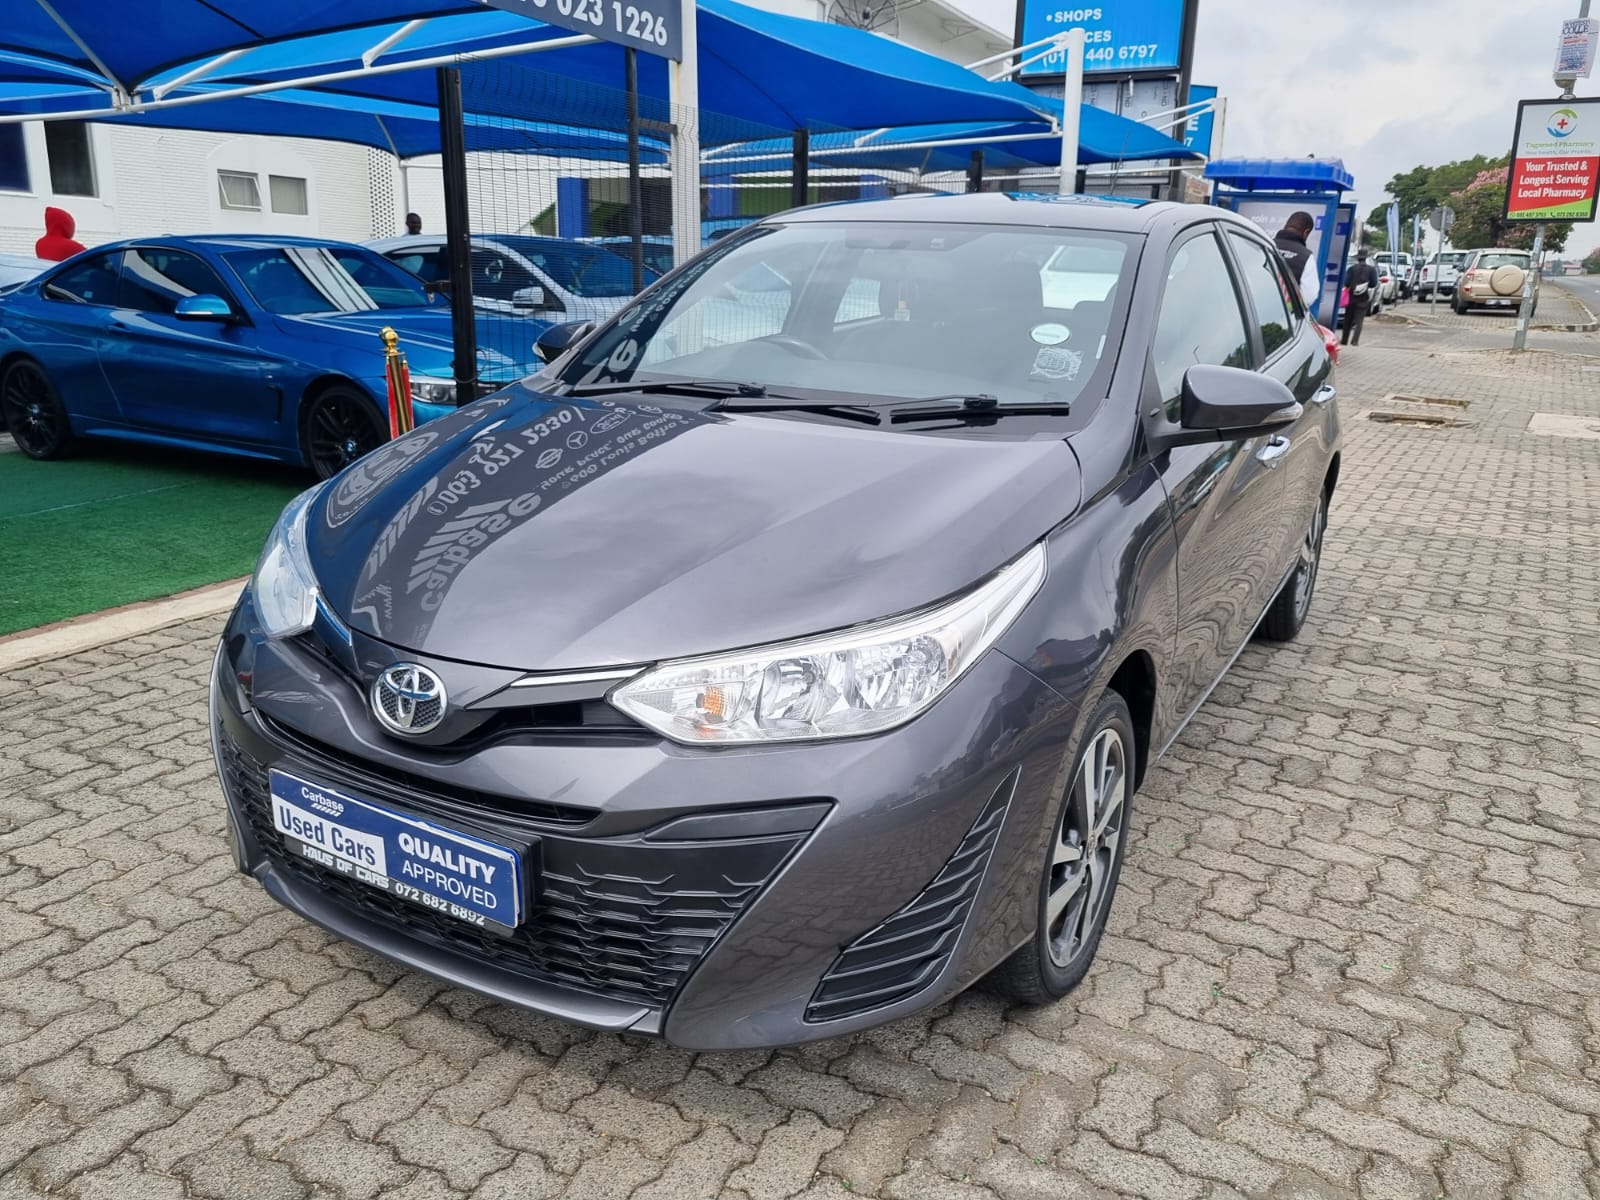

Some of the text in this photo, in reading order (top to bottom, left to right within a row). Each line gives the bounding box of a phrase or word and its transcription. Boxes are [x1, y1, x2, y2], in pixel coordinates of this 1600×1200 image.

[612, 2, 668, 46] 1226
[1054, 8, 1102, 23] SHOPS
[1086, 48, 1114, 62] 440
[1118, 44, 1158, 60] 6797
[1525, 160, 1588, 172] Your Trusted &
[1518, 187, 1587, 199] Local Pharmacy
[1519, 174, 1590, 186] Longest Serving
[301, 787, 345, 813] Carbase
[280, 805, 376, 866] Used Cars
[398, 832, 496, 885] QUALITY
[302, 844, 485, 926] HAUS OF CARS 072 682 6892
[402, 860, 497, 909] APPROVED
